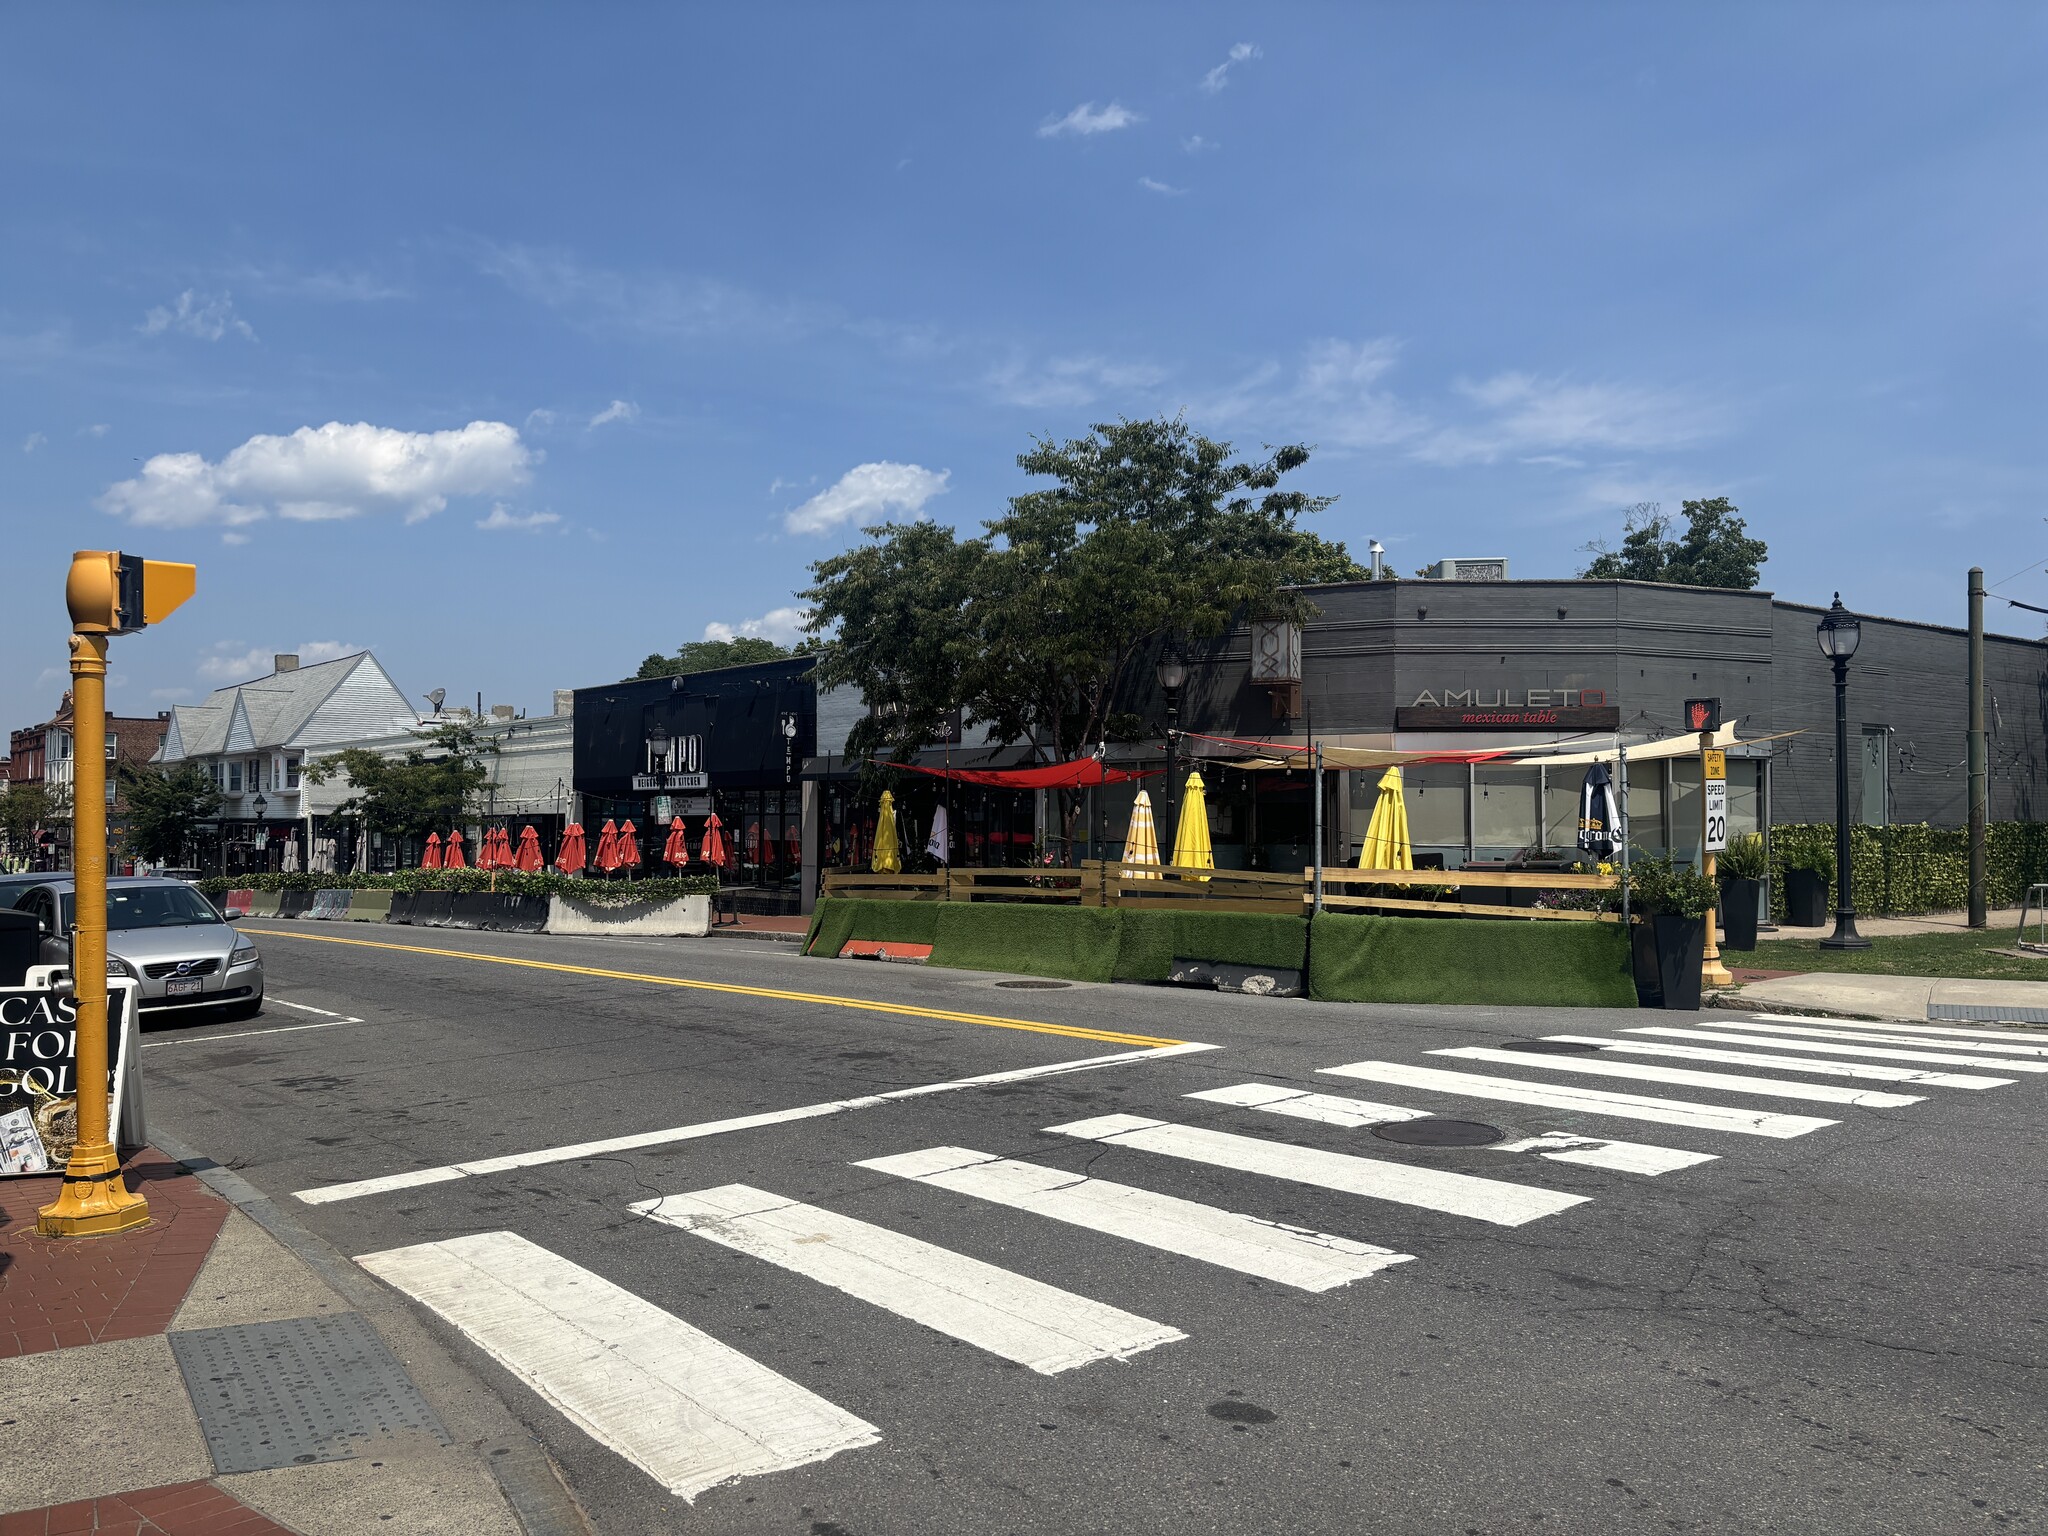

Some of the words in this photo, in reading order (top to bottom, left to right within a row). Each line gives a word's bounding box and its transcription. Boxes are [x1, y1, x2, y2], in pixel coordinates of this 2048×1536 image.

[1411, 688, 1606, 707] AMULETO
[1461, 711, 1520, 723] mexican
[1522, 710, 1557, 723] table
[1707, 753, 1721, 762] SAFETY
[1710, 766, 1720, 775] ZONE
[1707, 785, 1724, 795] SPEED
[1709, 799, 1723, 811] LIMIT
[1707, 815, 1725, 842] 20
[190, 981, 200, 990] 21
[0, 995, 112, 1026] CAS
[0, 1065, 110, 1097] GOL
